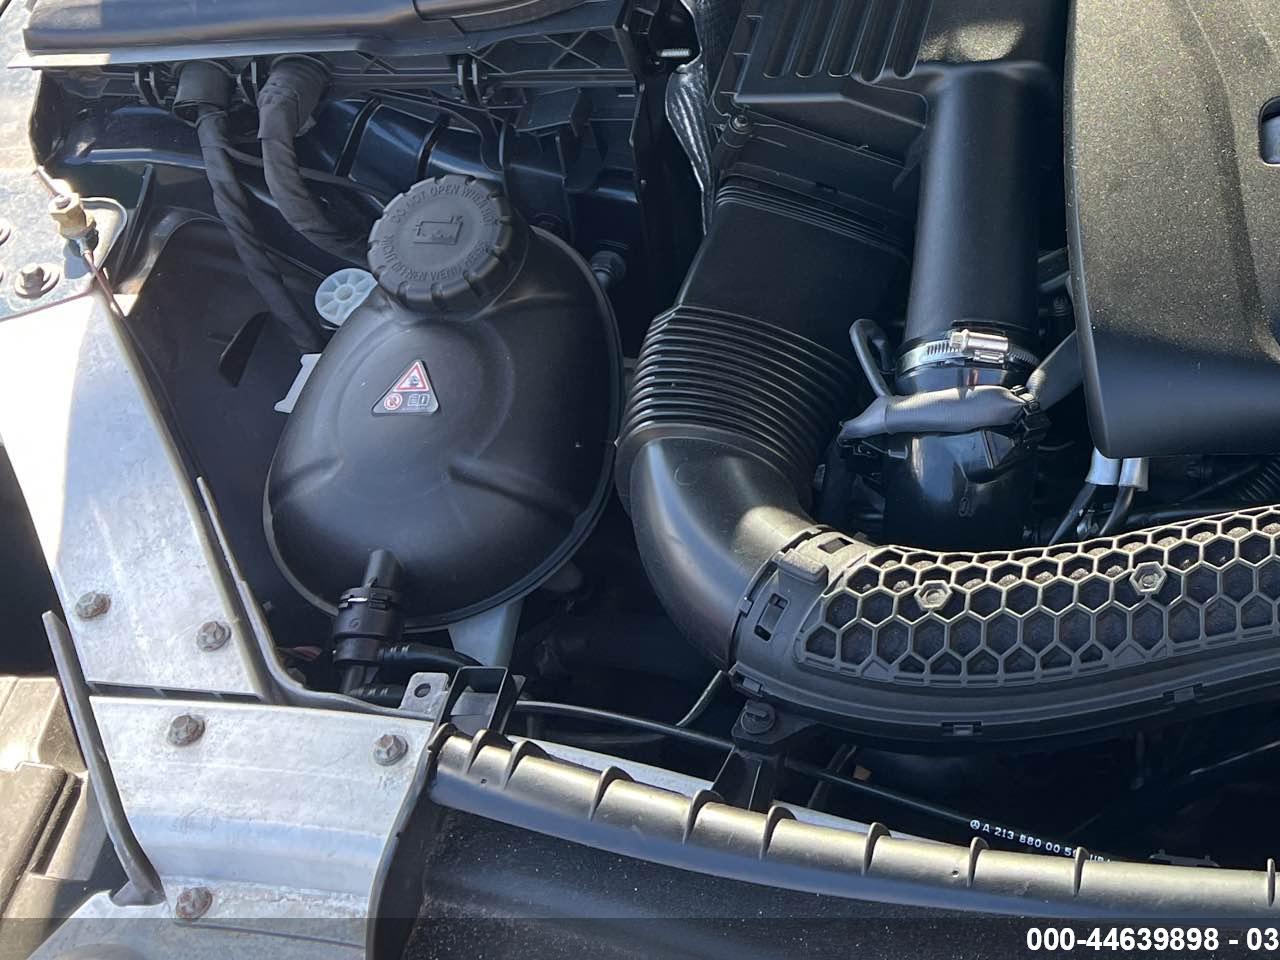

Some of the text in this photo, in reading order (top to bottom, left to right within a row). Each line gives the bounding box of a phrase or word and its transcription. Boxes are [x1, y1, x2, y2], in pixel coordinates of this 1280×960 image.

[430, 184, 460, 197] OPEN
[982, 823, 990, 833] A
[994, 826, 1015, 840] 213
[1018, 834, 1042, 848] 880
[1045, 841, 1061, 854] 00
